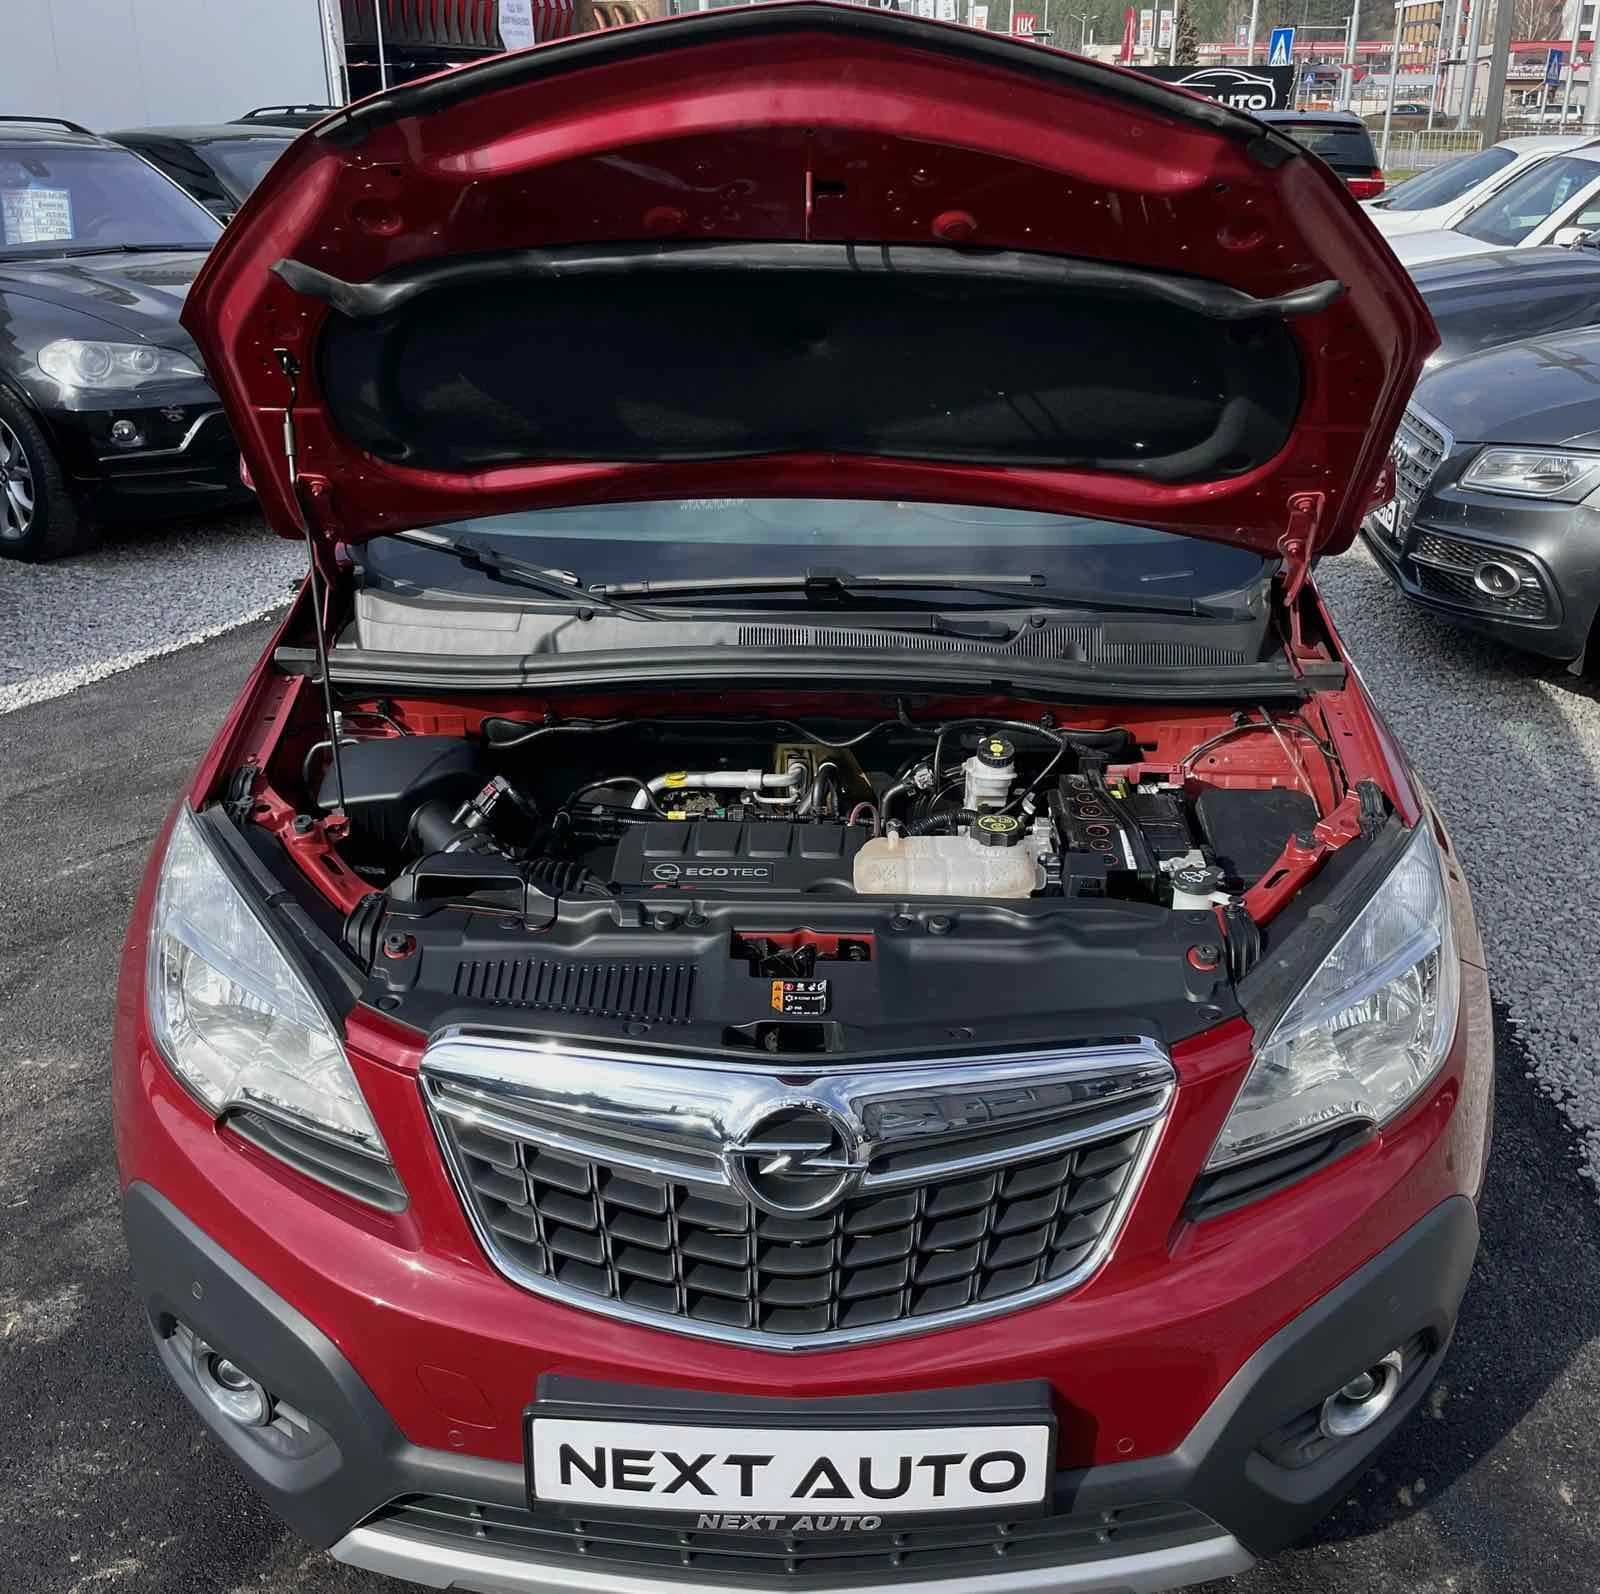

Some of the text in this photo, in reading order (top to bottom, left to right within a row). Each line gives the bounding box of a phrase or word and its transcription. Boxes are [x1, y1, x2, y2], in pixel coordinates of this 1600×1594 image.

[685, 867, 769, 877] ECOTEC
[559, 1443, 1027, 1500] NEXT AUTO
[697, 1514, 882, 1532] NEXT AUTO
